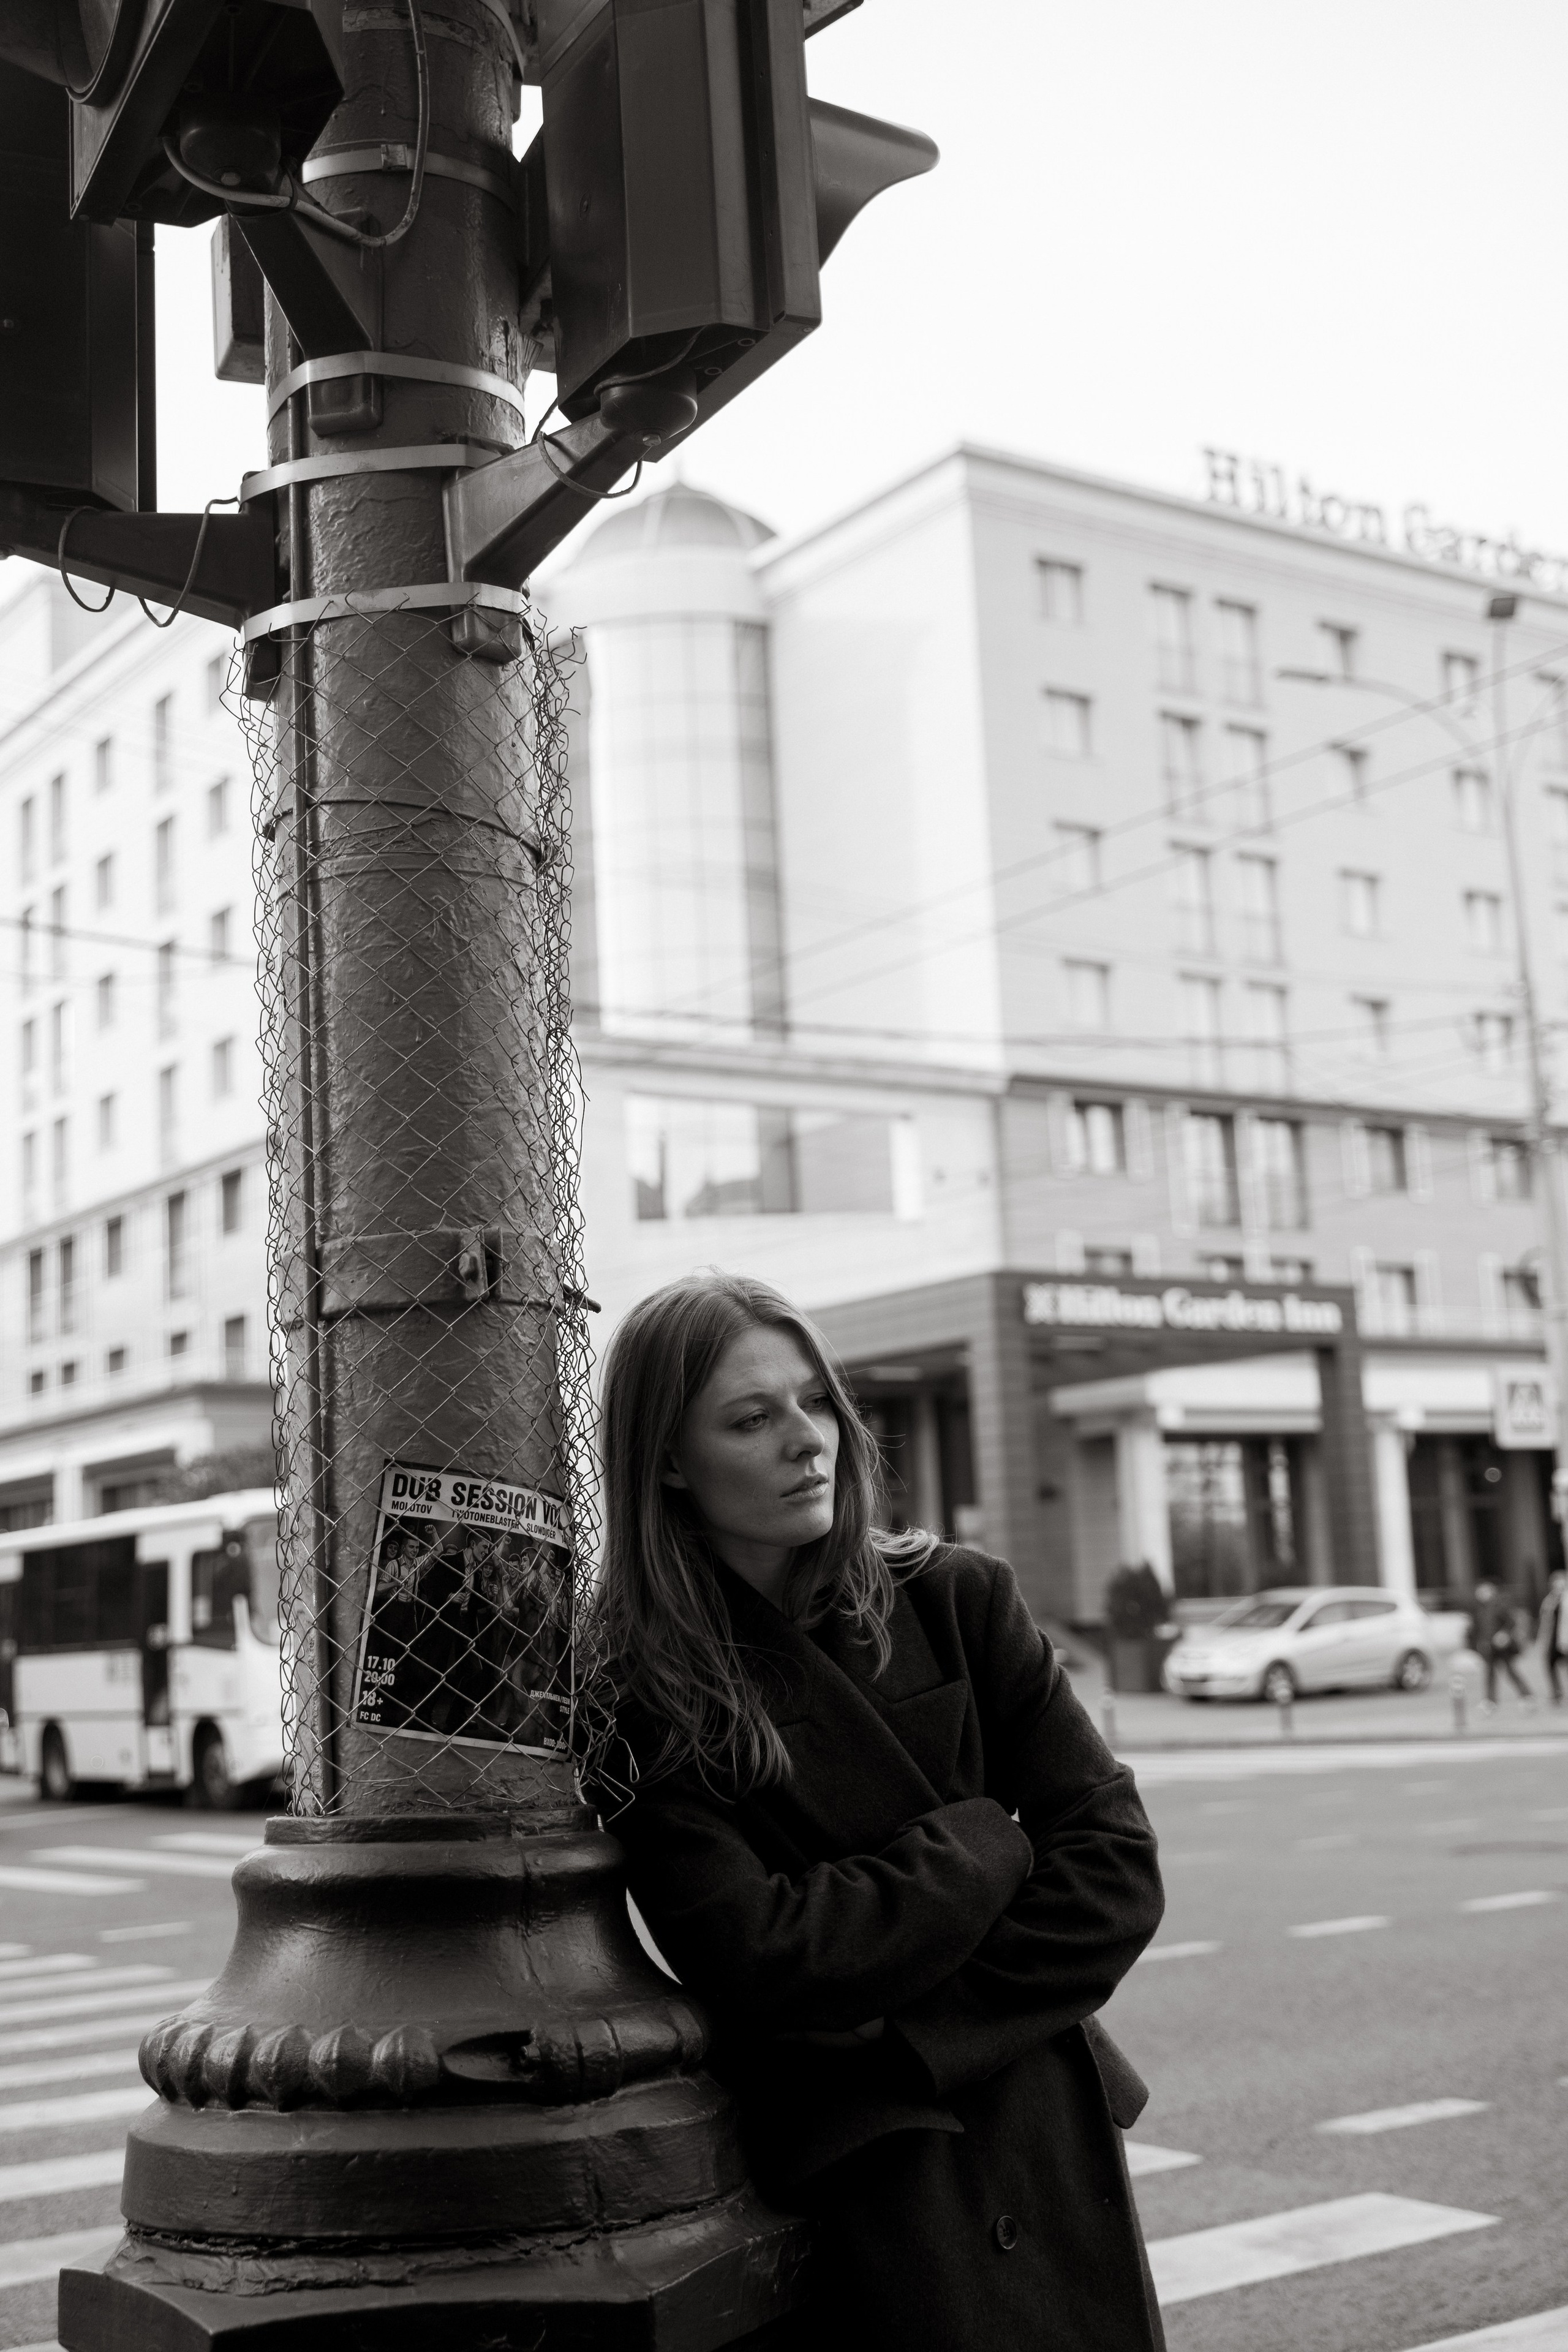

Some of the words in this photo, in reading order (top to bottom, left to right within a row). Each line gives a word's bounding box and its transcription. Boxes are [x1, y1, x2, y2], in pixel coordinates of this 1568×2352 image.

[1203, 446, 1386, 544] Hilton
[1404, 503, 1568, 593] Garde
[1057, 1284, 1163, 1329] Hilton
[1164, 1287, 1283, 1333] Garden
[1284, 1293, 1343, 1335] Inn
[391, 1473, 442, 1502] DUB
[450, 1482, 538, 1521] SESSION
[391, 1500, 433, 1515] MOLOTOV
[451, 1509, 519, 1529] TWOTONEBLASTER
[368, 1656, 395, 1671] 17.10
[364, 1670, 394, 1685] 20:00
[363, 1691, 383, 1706] 18+
[360, 1711, 369, 1720] FC
